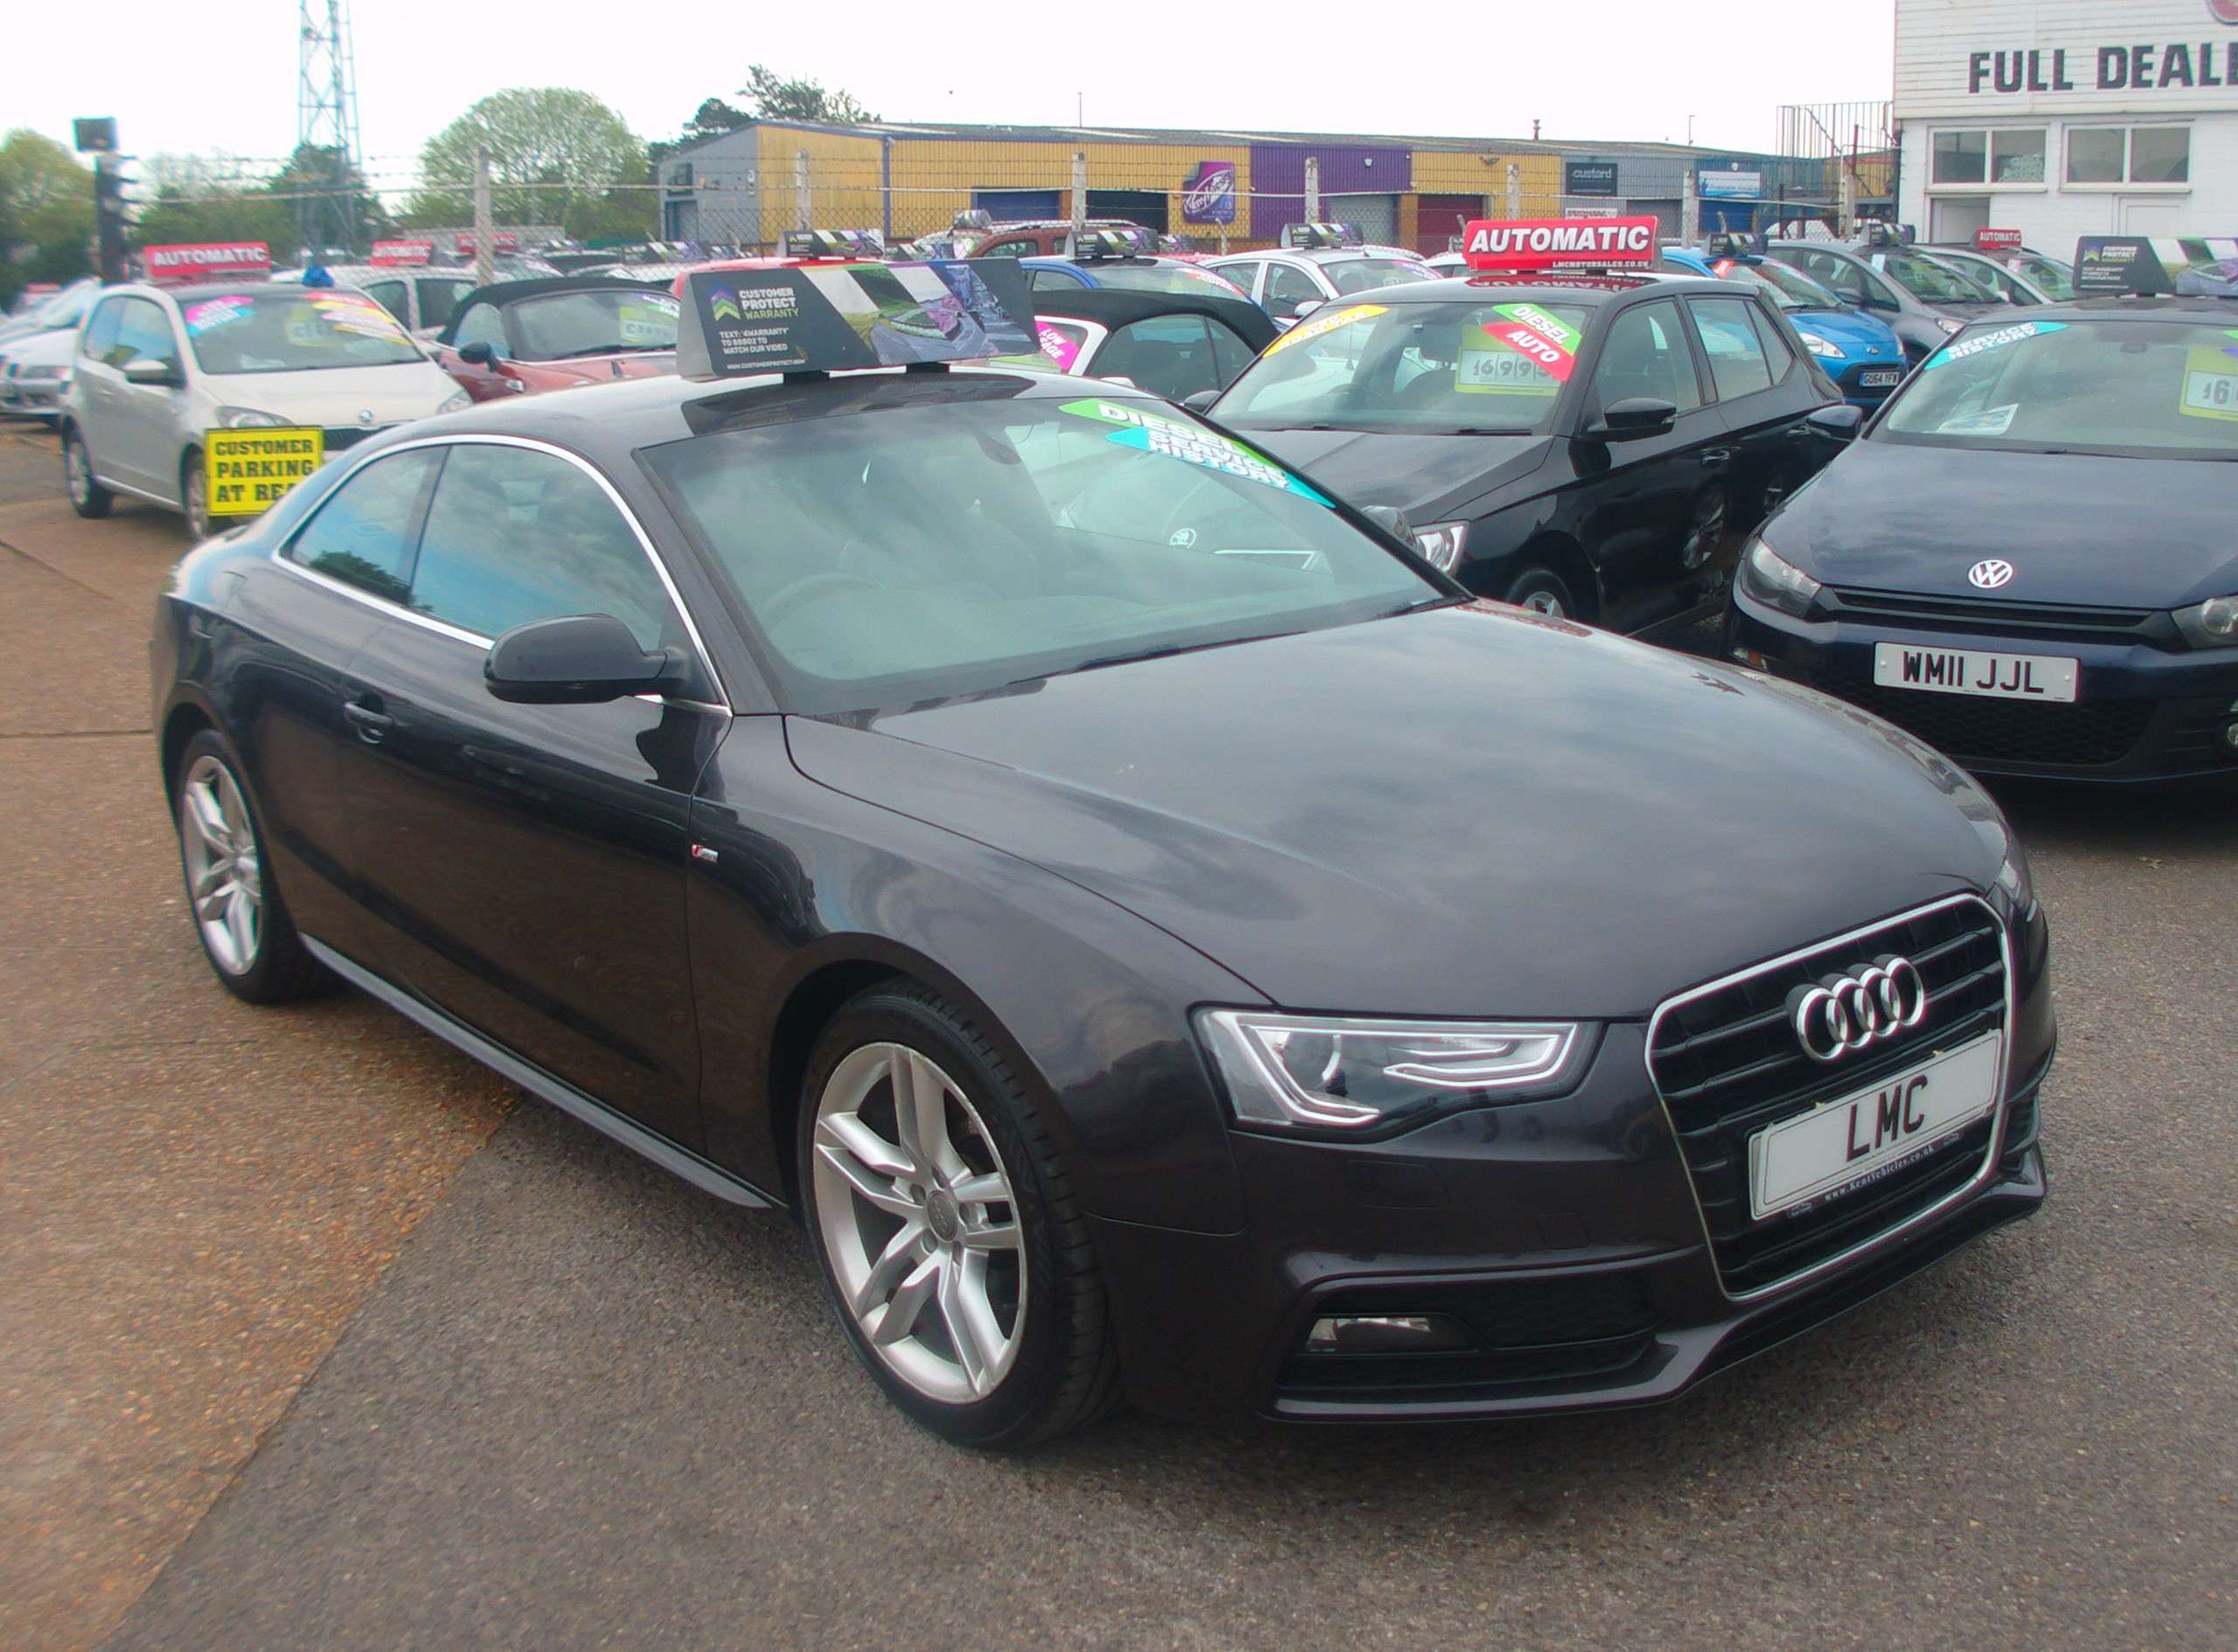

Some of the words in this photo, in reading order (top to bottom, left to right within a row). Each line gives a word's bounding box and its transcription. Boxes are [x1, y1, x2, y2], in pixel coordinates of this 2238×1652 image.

[1969, 48, 2073, 94] FULL
[1573, 168, 1611, 179] custard
[1469, 226, 1650, 253] AUTOMATIC
[1979, 231, 2021, 242] AUTOMATIC
[153, 247, 267, 266] AUTOMATIC
[739, 287, 795, 300] CUSTOMER
[741, 297, 796, 310] PROTECT
[744, 308, 799, 321] WARRANTY
[1511, 306, 1570, 345] DIESEL
[757, 337, 768, 345] TO
[1039, 329, 1067, 345] LOW
[1505, 330, 1560, 363] AUTO
[1947, 322, 2033, 354] SERVICE
[723, 346, 749, 355] WATCH
[767, 343, 789, 352] VIDEO
[1097, 403, 1248, 455] DIESEL
[215, 439, 313, 455] CUSTOMER
[1148, 429, 1286, 478] SERVICE
[216, 459, 314, 478] PARKING
[1148, 440, 1289, 489] HISTORY
[216, 484, 245, 503] AT
[1902, 650, 1964, 687] WM11
[1975, 658, 2045, 694] JJL
[1845, 1074, 1929, 1163] LMC
